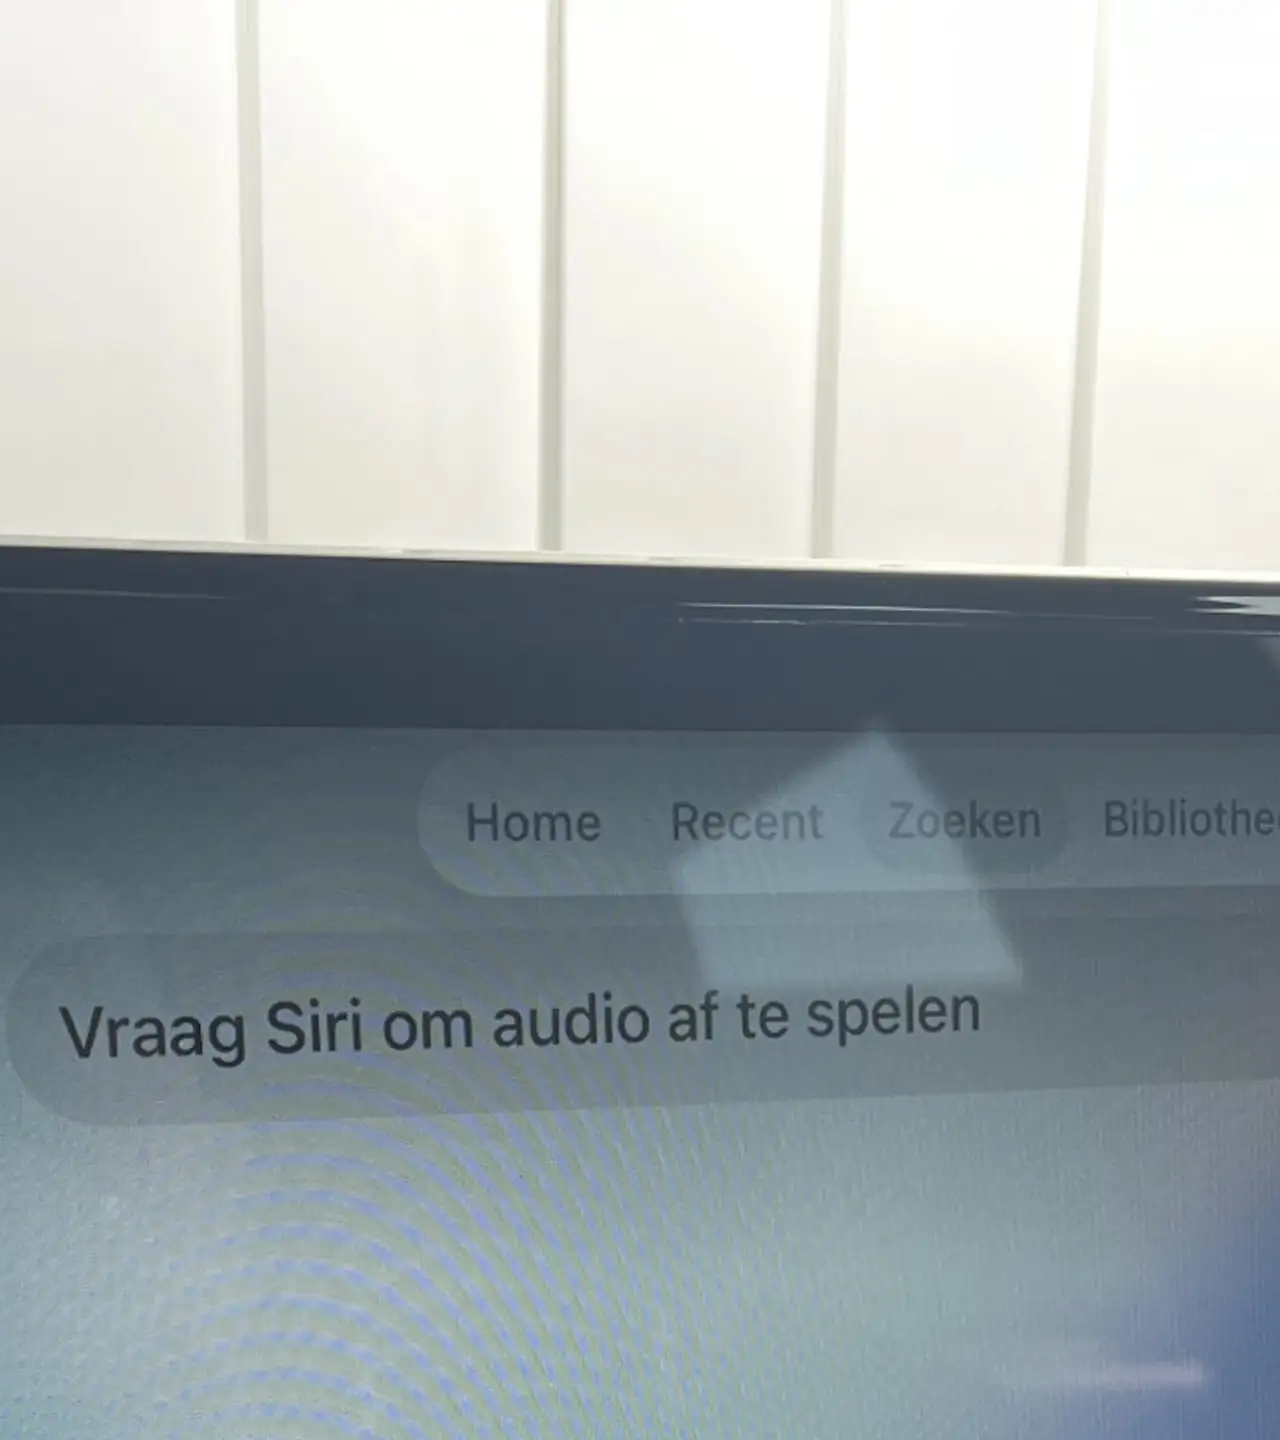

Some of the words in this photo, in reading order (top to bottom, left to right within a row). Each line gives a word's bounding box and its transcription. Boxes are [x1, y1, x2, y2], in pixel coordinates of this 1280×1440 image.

[465, 802, 603, 843] Home
[671, 801, 824, 842] Recent
[887, 801, 1042, 841] Zoeken
[58, 1004, 247, 1069] Vraag
[266, 996, 363, 1056] Siri
[382, 1008, 474, 1052] om
[492, 990, 650, 1049] audio
[667, 990, 720, 1042] af
[734, 995, 789, 1041] te
[806, 984, 980, 1048] spelen
